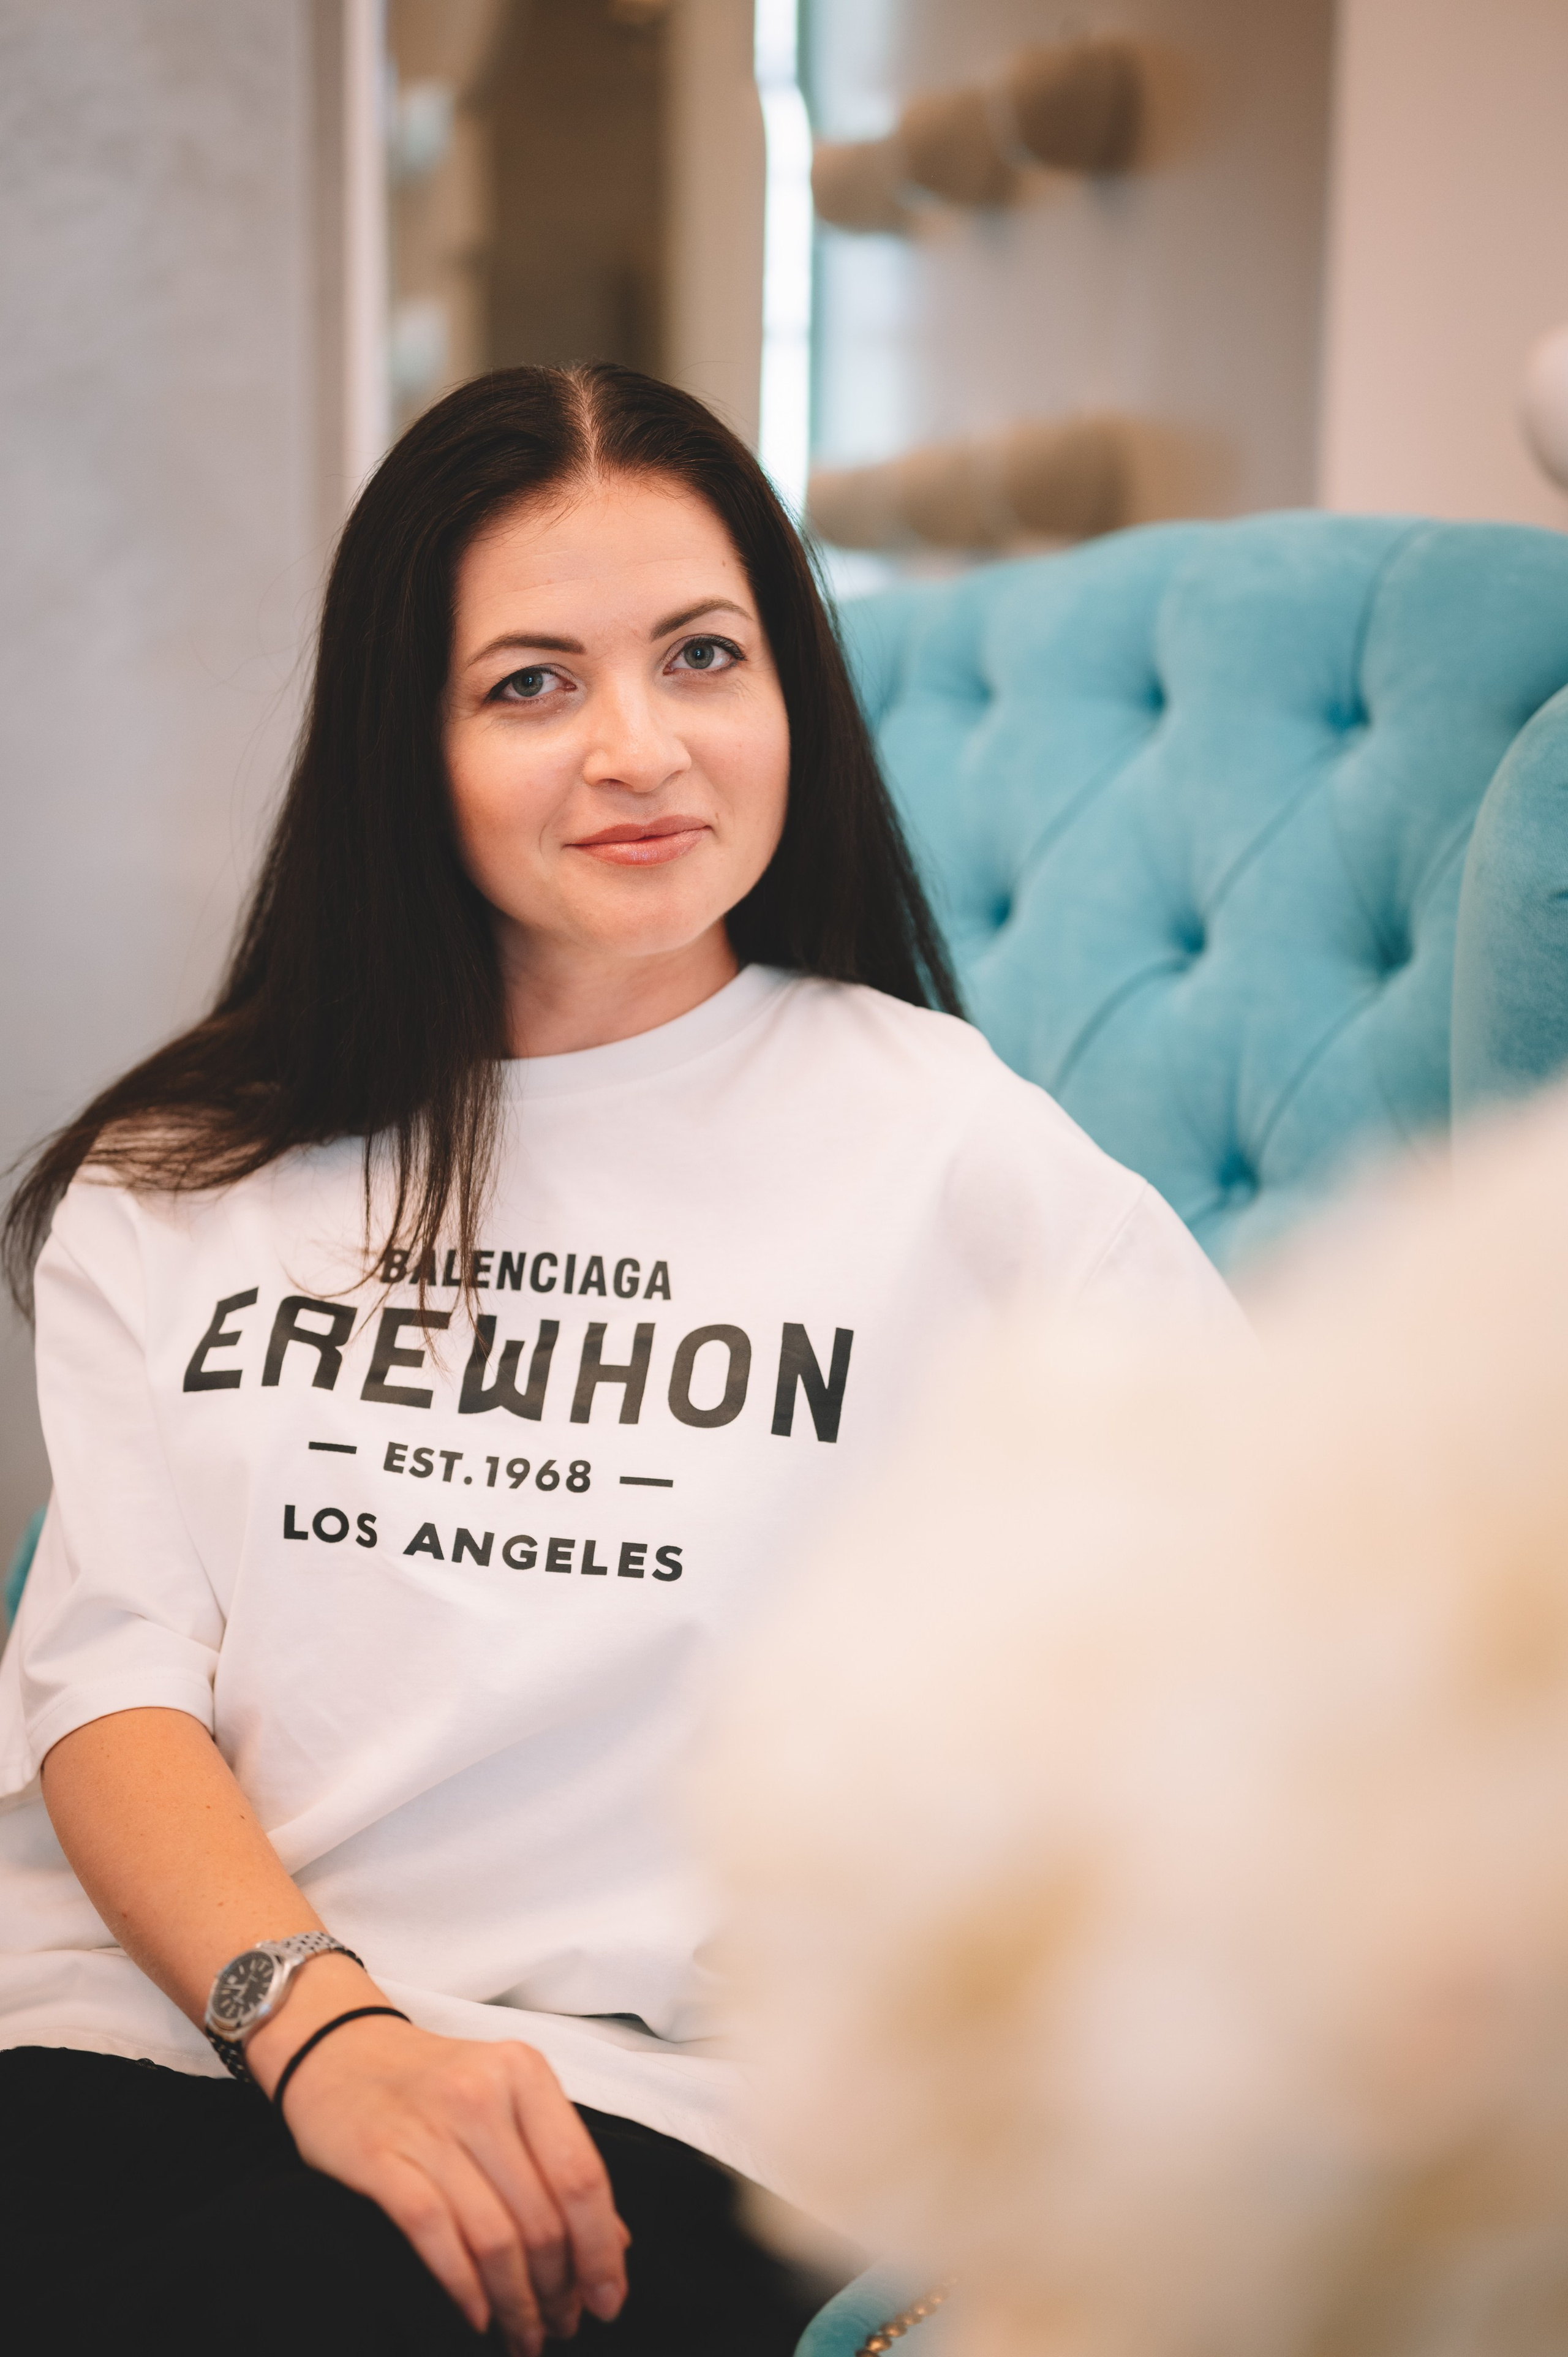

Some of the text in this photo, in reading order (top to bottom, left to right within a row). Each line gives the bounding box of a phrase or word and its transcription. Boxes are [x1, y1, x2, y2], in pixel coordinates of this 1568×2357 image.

[380, 1248, 672, 1301] BALENCIAGA
[183, 1287, 854, 1444] EREWHON
[383, 1441, 592, 1493] EST.1968
[283, 1504, 684, 1582] LOS ANGELES
